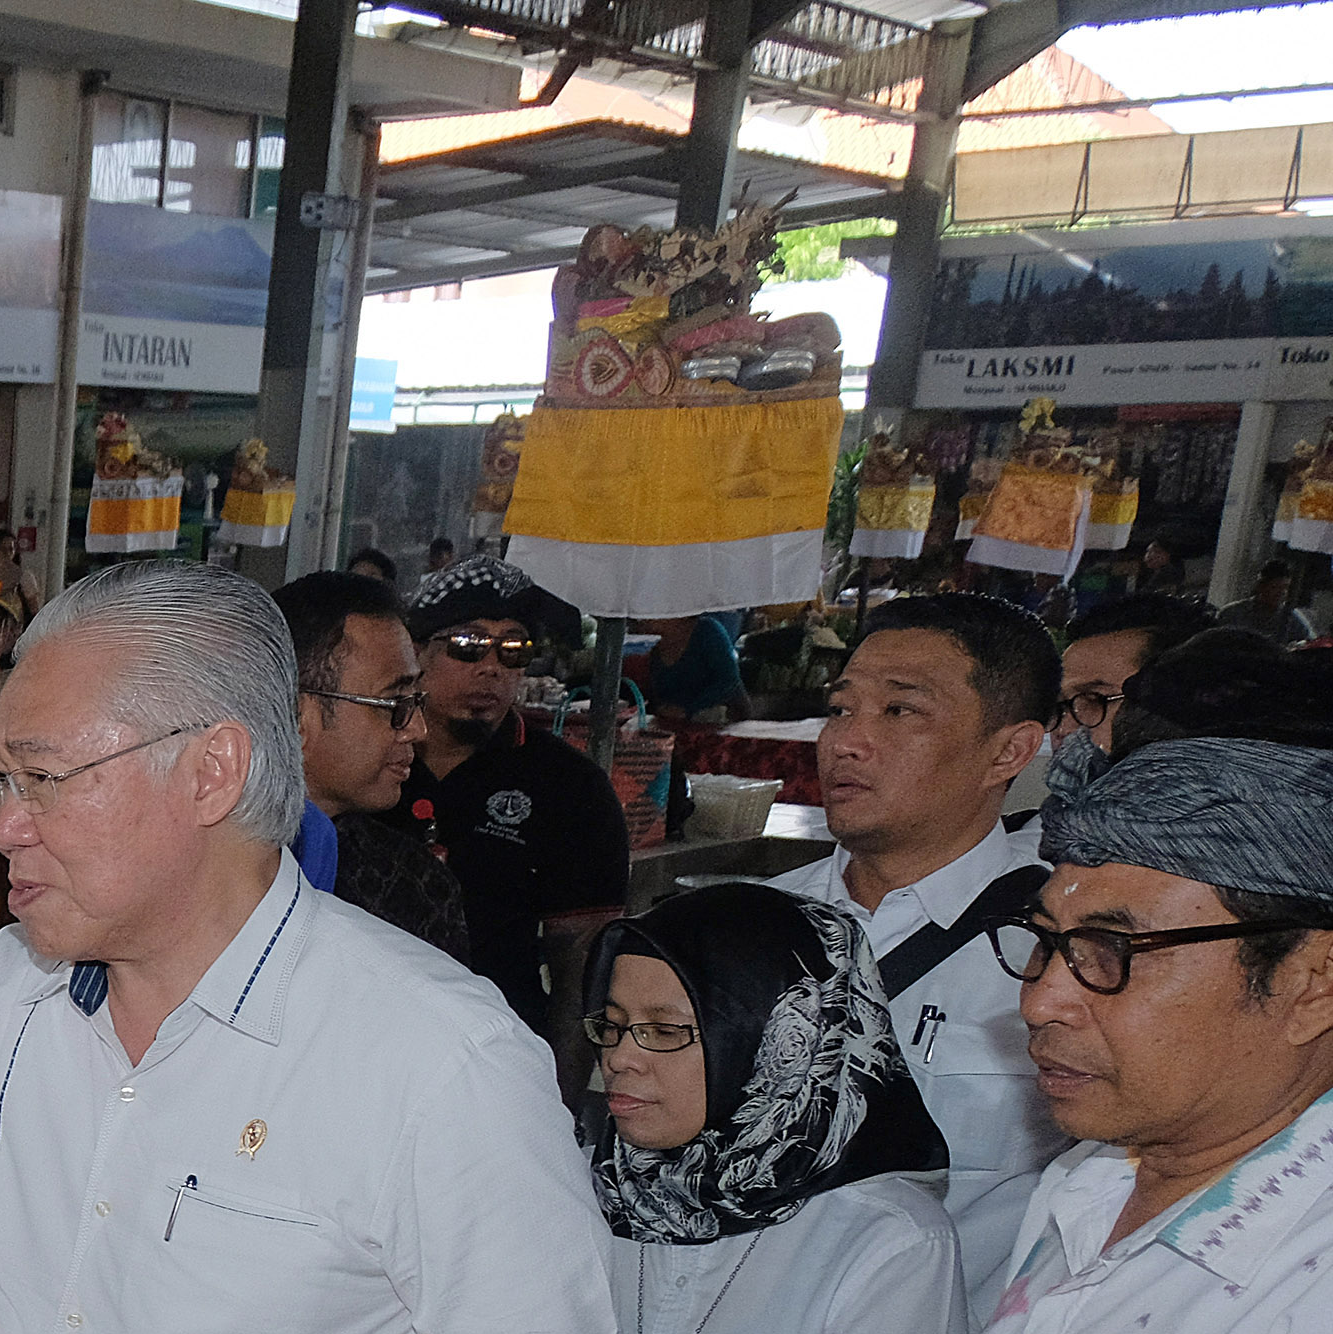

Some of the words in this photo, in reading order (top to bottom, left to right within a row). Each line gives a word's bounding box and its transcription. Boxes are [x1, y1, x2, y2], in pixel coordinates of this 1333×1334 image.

[102, 332, 192, 367] INTARAN
[1278, 345, 1331, 365] Toko
[966, 355, 1075, 378] LAKSMI
